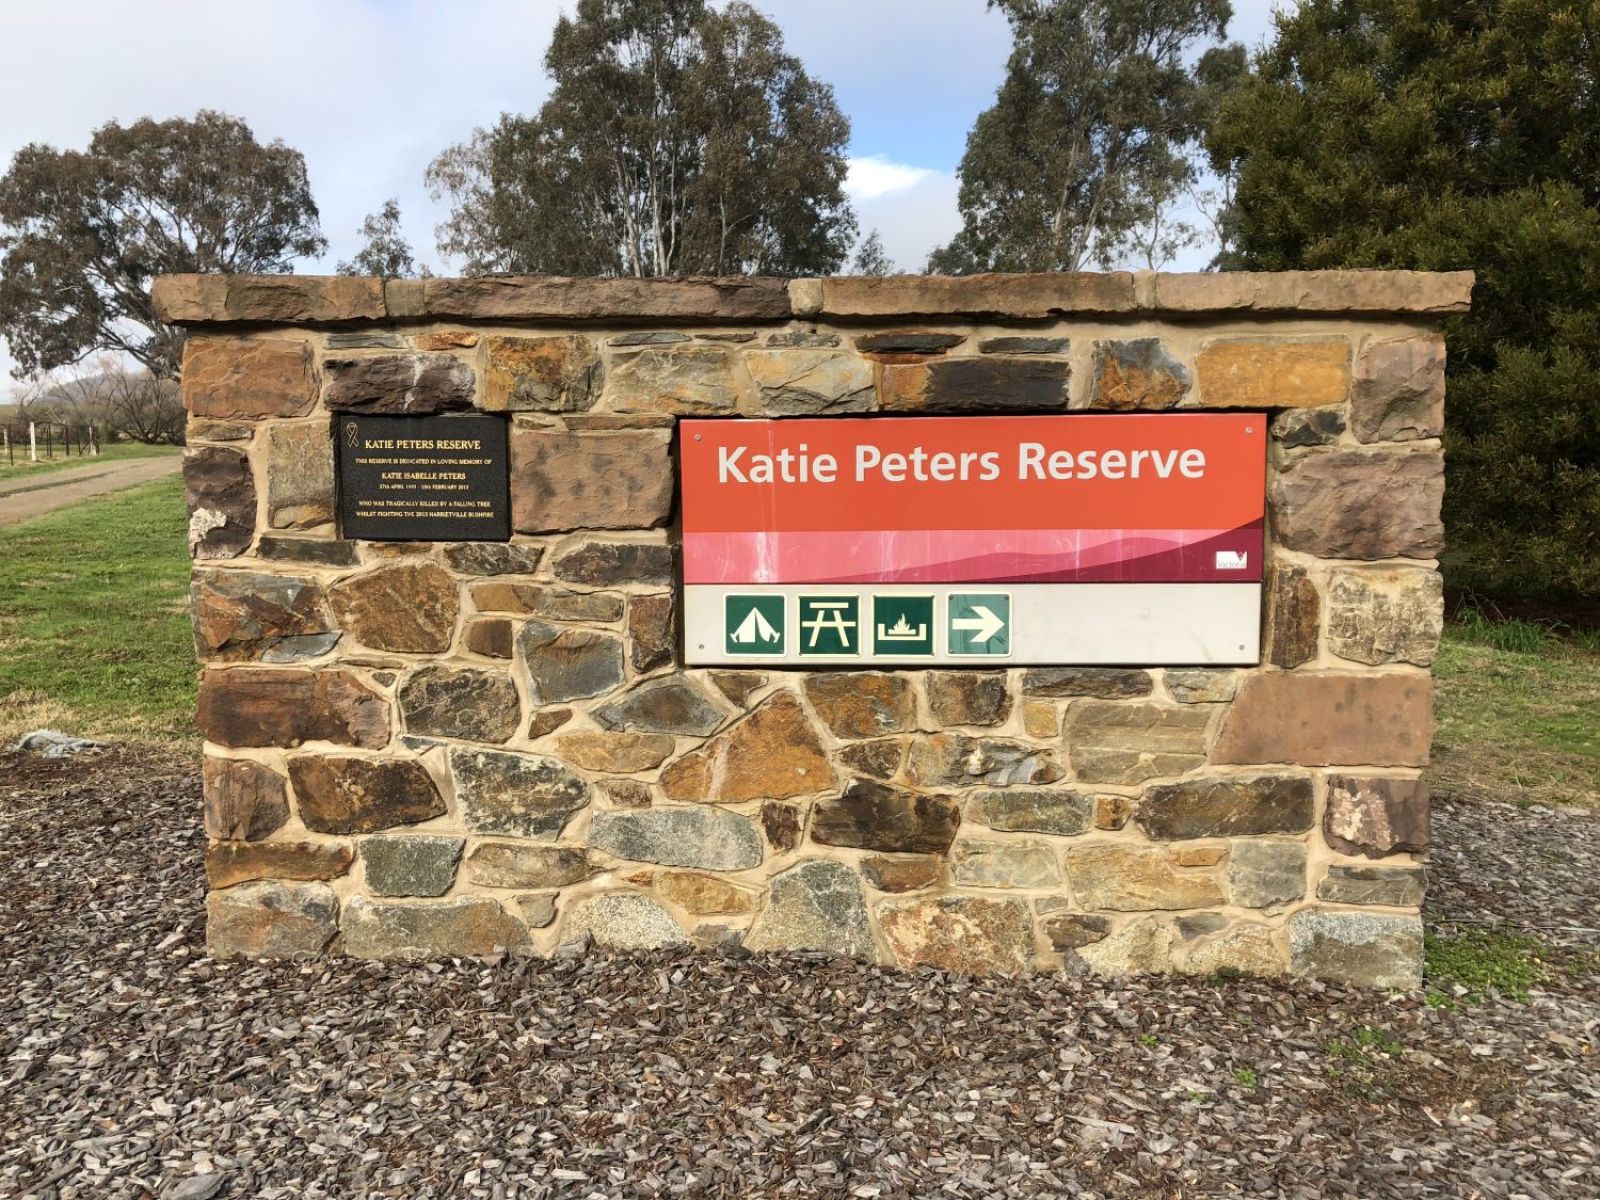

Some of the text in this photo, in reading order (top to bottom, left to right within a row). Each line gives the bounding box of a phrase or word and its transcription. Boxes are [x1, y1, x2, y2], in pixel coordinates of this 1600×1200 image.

[365, 440, 481, 450] KATIE PETERS RESERVE
[717, 442, 1206, 483] Katie Peters Reserve
[381, 472, 466, 480] KATIE ISABELLE PETERS
